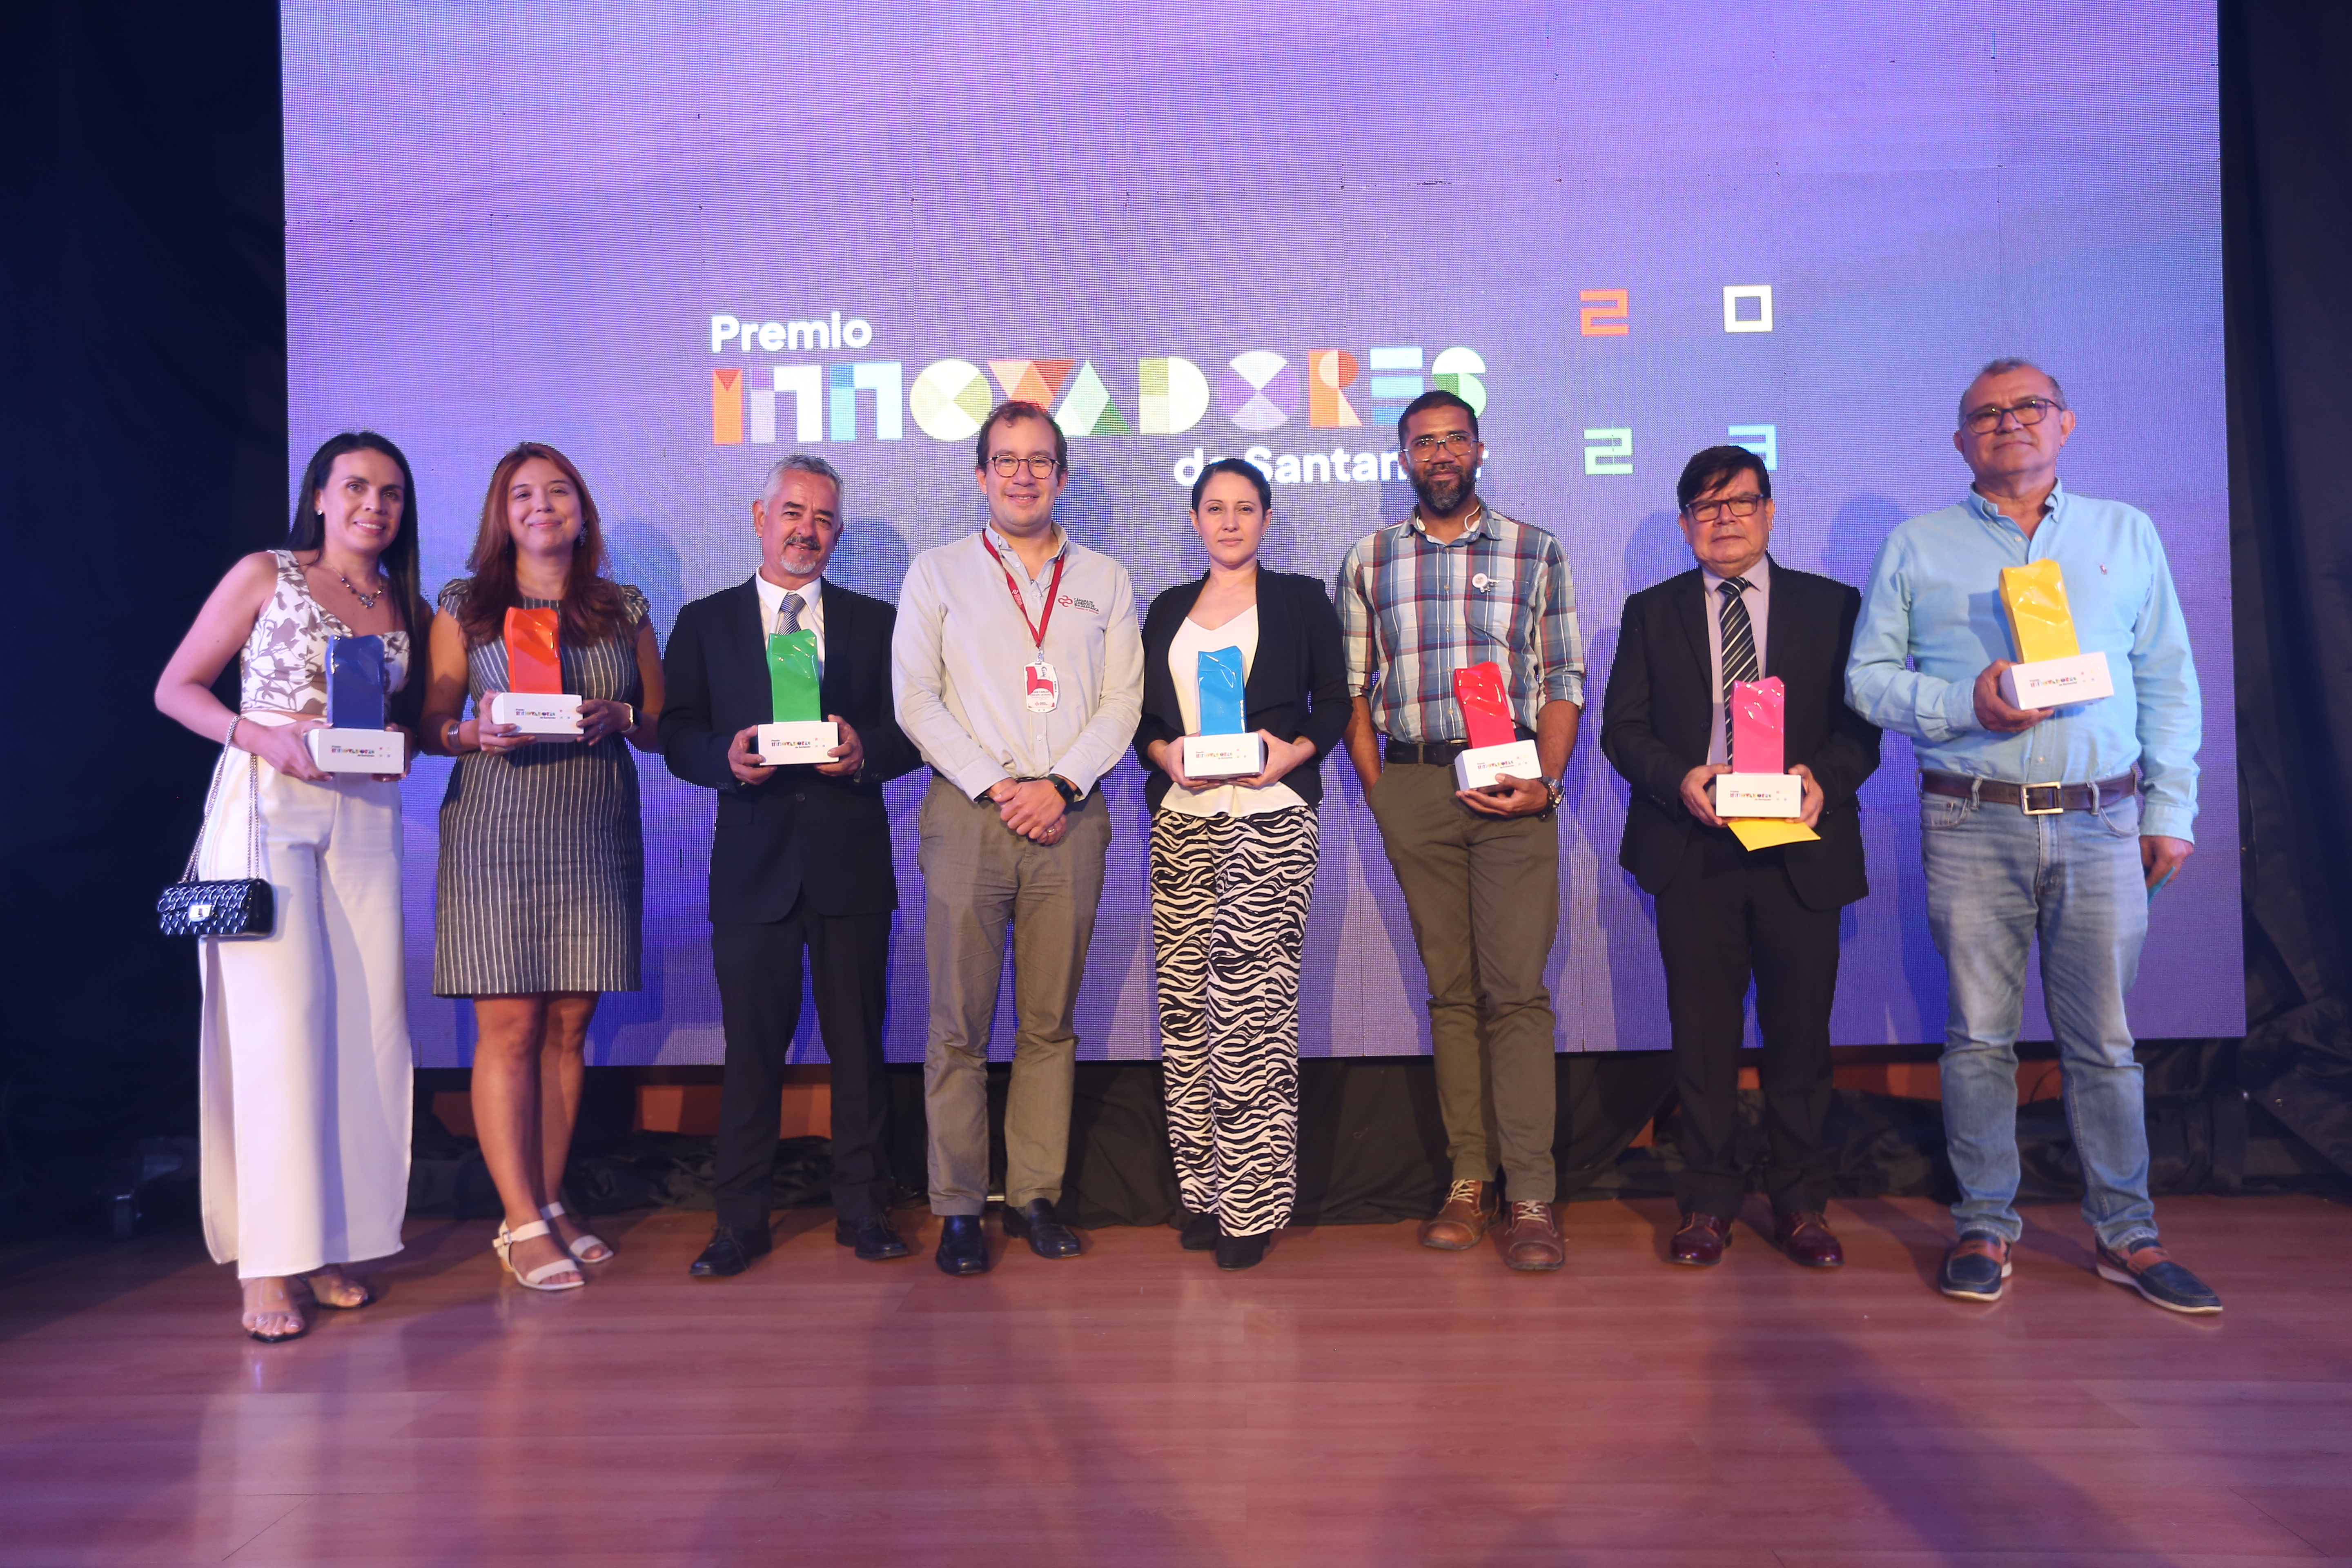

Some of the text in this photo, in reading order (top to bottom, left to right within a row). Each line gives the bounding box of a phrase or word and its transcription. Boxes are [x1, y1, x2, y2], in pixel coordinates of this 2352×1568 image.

[711, 311, 872, 352] Premio
[712, 346, 1488, 445] INNOVADORES
[1174, 447, 1226, 486] d
